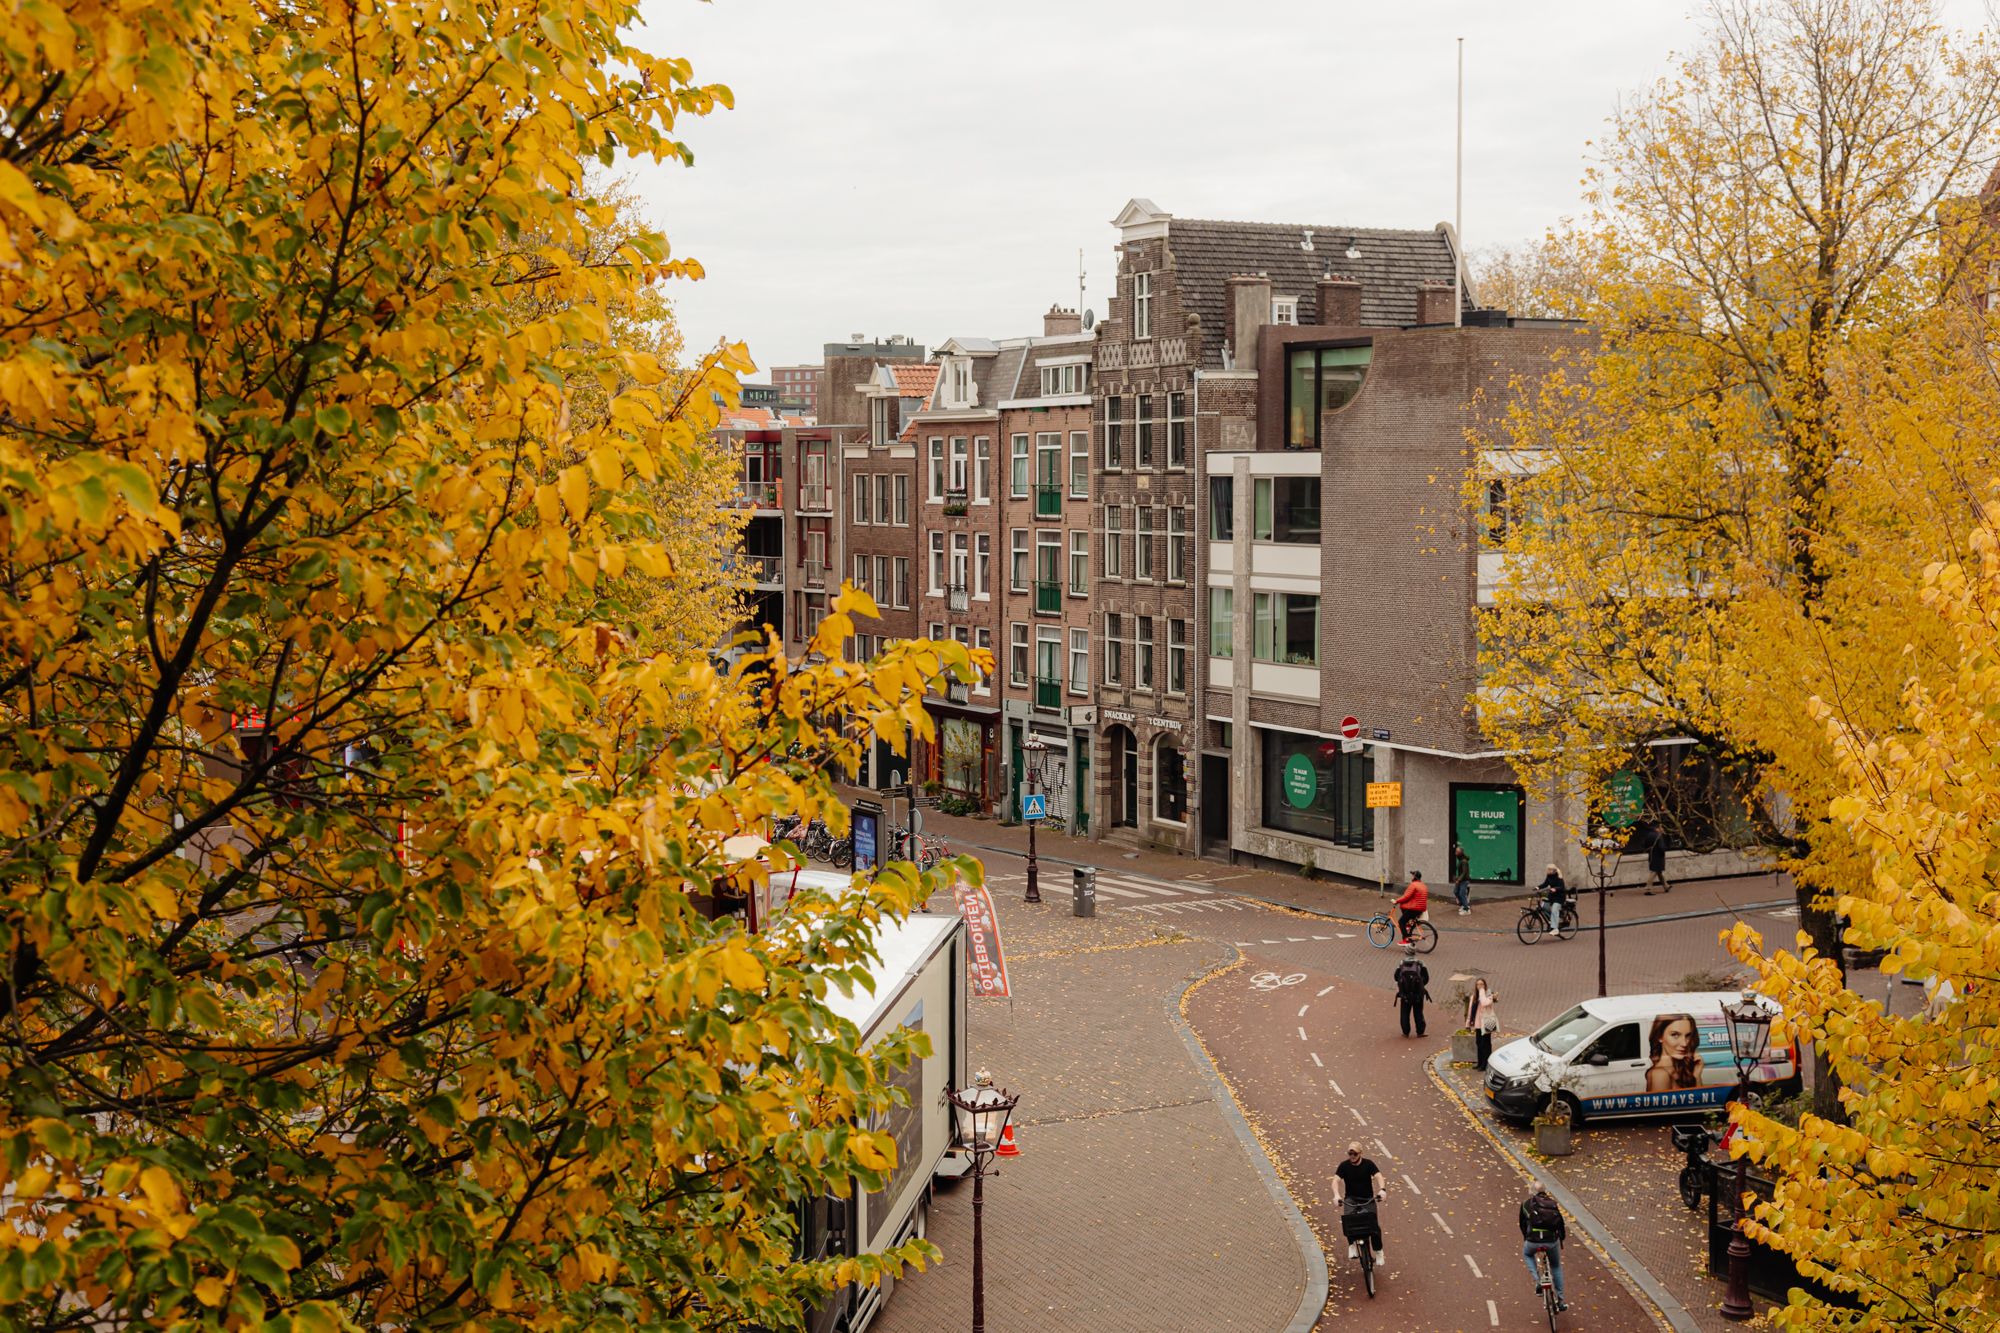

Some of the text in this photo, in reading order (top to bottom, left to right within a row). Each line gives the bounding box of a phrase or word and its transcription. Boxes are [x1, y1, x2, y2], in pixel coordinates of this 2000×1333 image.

[989, 727, 994, 739] 8
[1469, 810, 1505, 819] TE HUUR
[1592, 1091, 1717, 1110] WWW.SUNDAYS.NL
